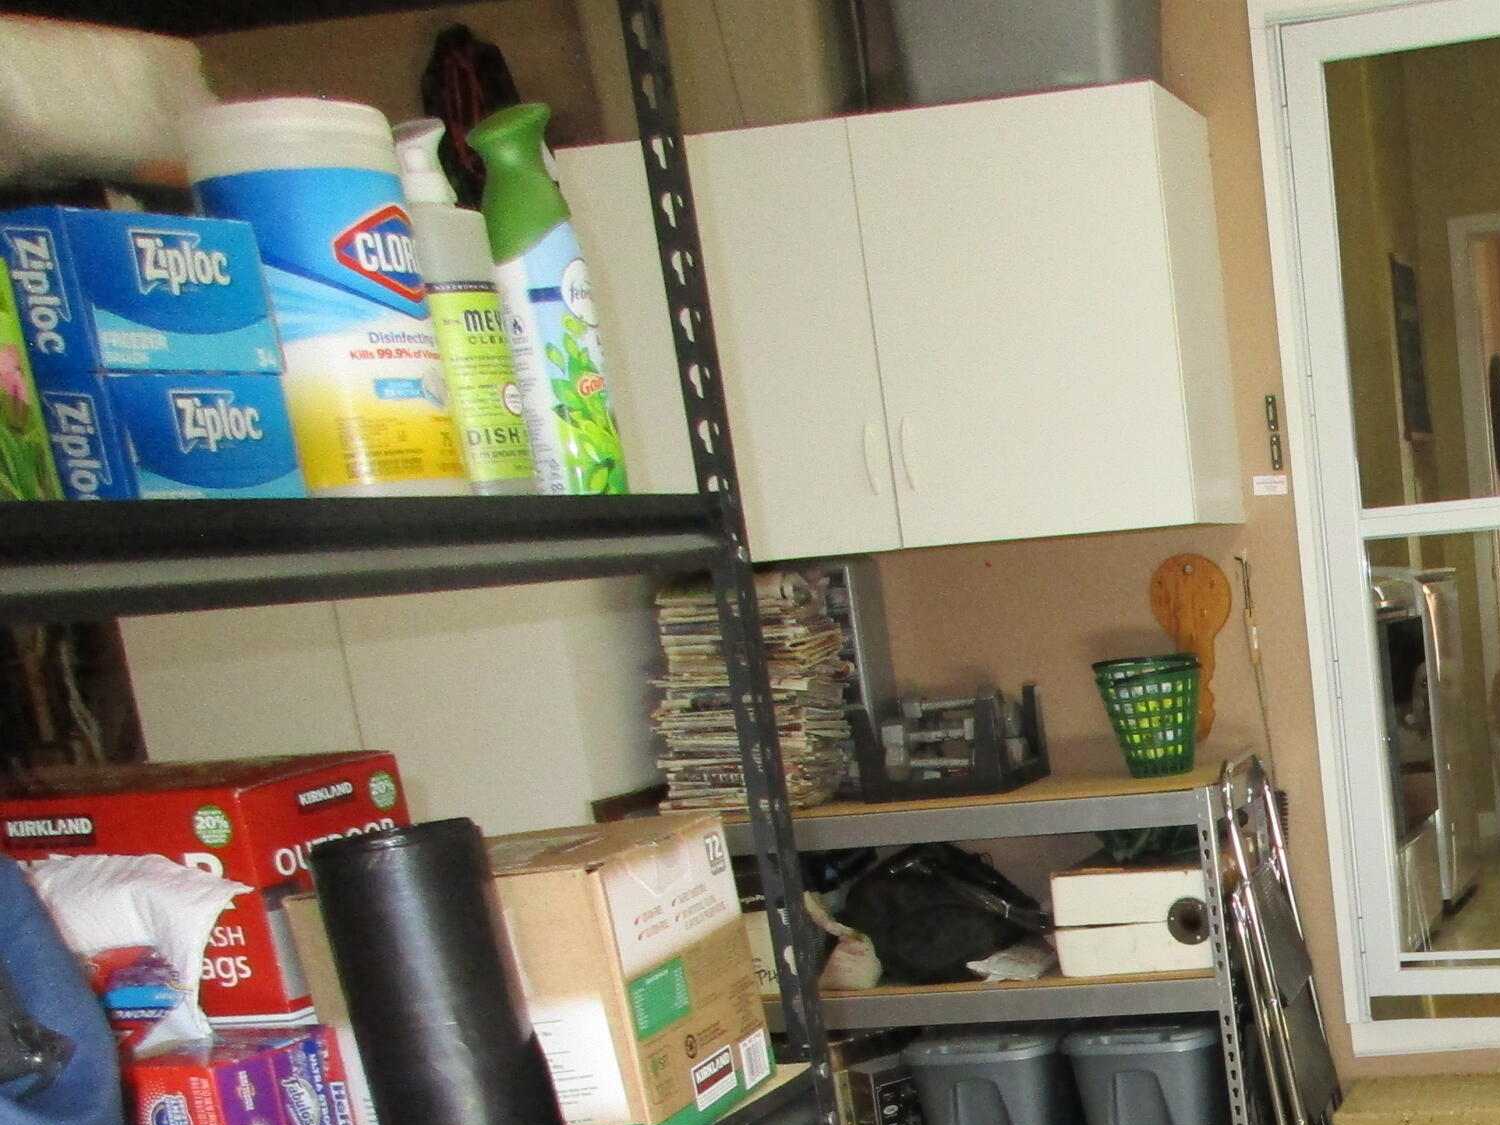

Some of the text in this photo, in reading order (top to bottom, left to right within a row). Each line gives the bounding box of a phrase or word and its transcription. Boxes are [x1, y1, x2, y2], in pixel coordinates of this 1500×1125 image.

[135, 236, 232, 296] Ziploc
[12, 234, 66, 356] Ziploc
[350, 350, 376, 361] Kills
[376, 347, 412, 360] 99.9%
[368, 332, 434, 348] Disinfecting
[175, 398, 263, 453] Ziploc
[465, 428, 521, 446] DISH
[52, 400, 105, 500] Ziplo
[298, 781, 354, 806] KIRKLAND
[7, 817, 94, 838] KIRKLAND
[704, 834, 724, 861] 72
[202, 954, 252, 988] ags
[308, 1053, 325, 1093] ULTRA
[694, 1051, 732, 1084] KIRKLAND
